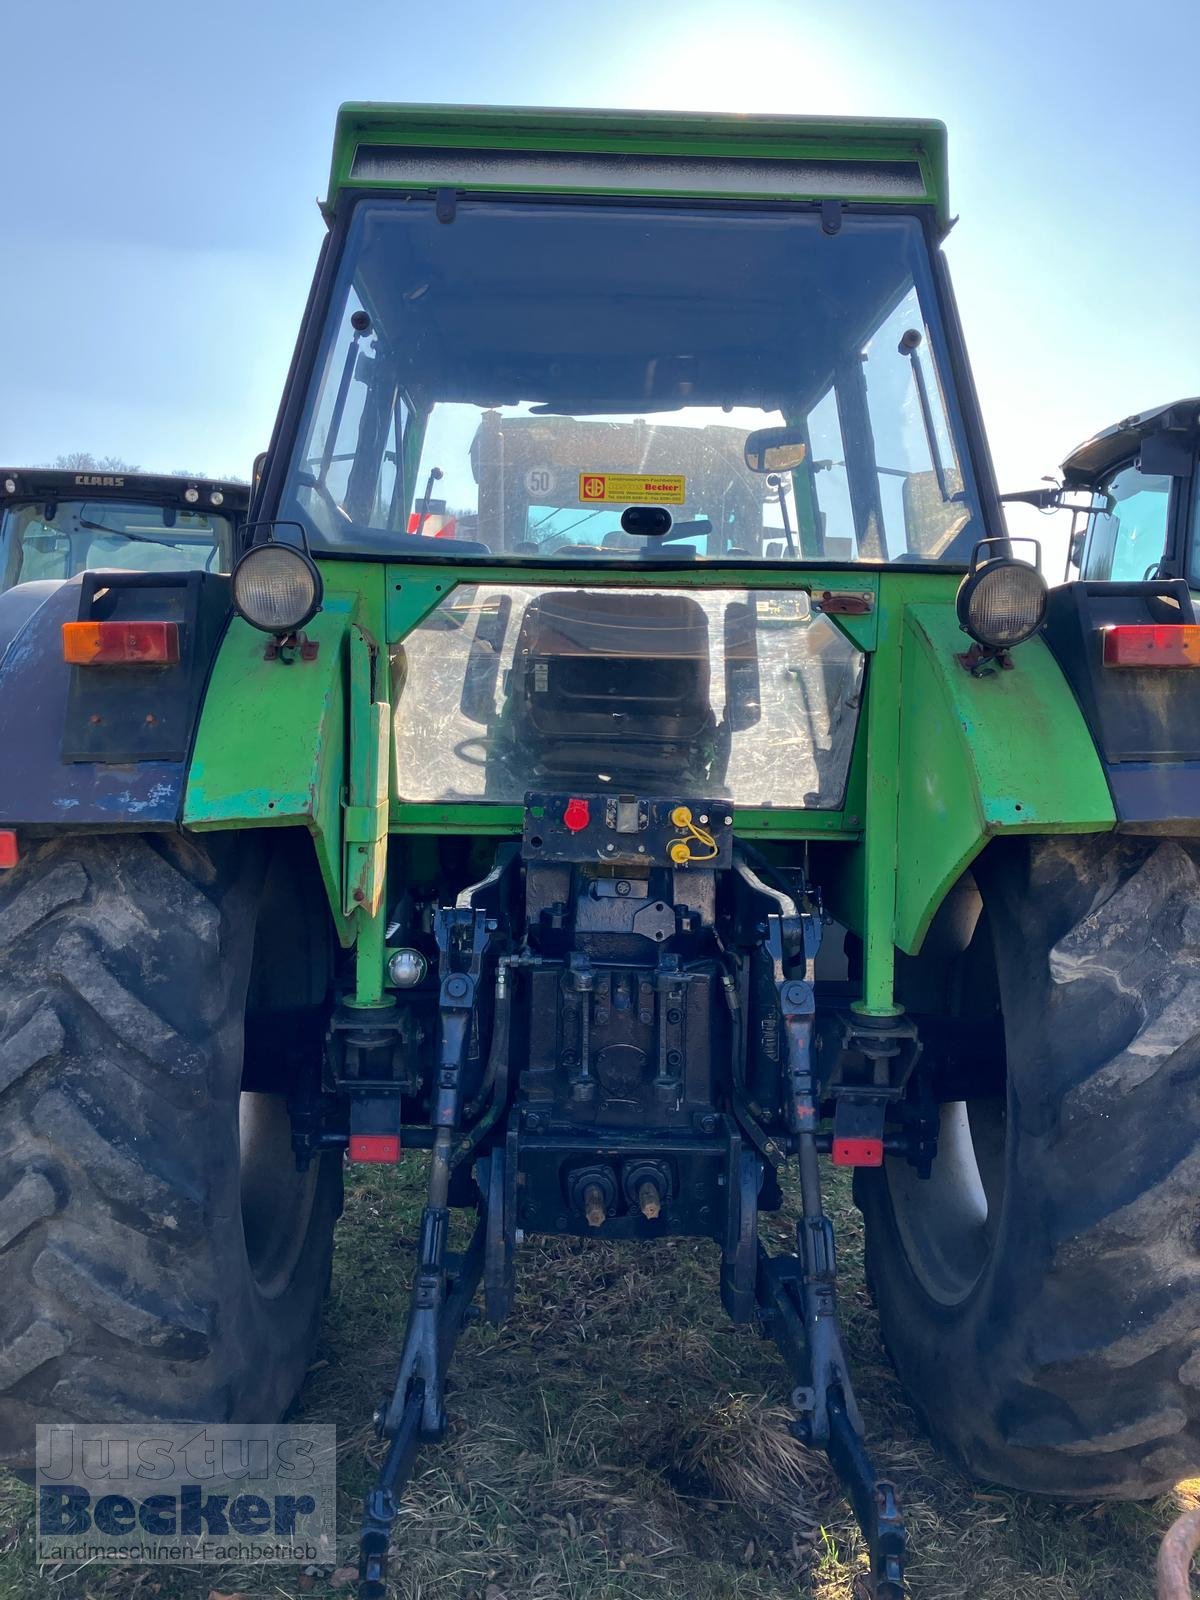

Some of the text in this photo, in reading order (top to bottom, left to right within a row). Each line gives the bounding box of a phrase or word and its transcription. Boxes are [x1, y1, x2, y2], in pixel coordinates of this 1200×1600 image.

[75, 475, 124, 487] CLAAS
[530, 471, 550, 492] 50
[644, 483, 679, 491] Becker
